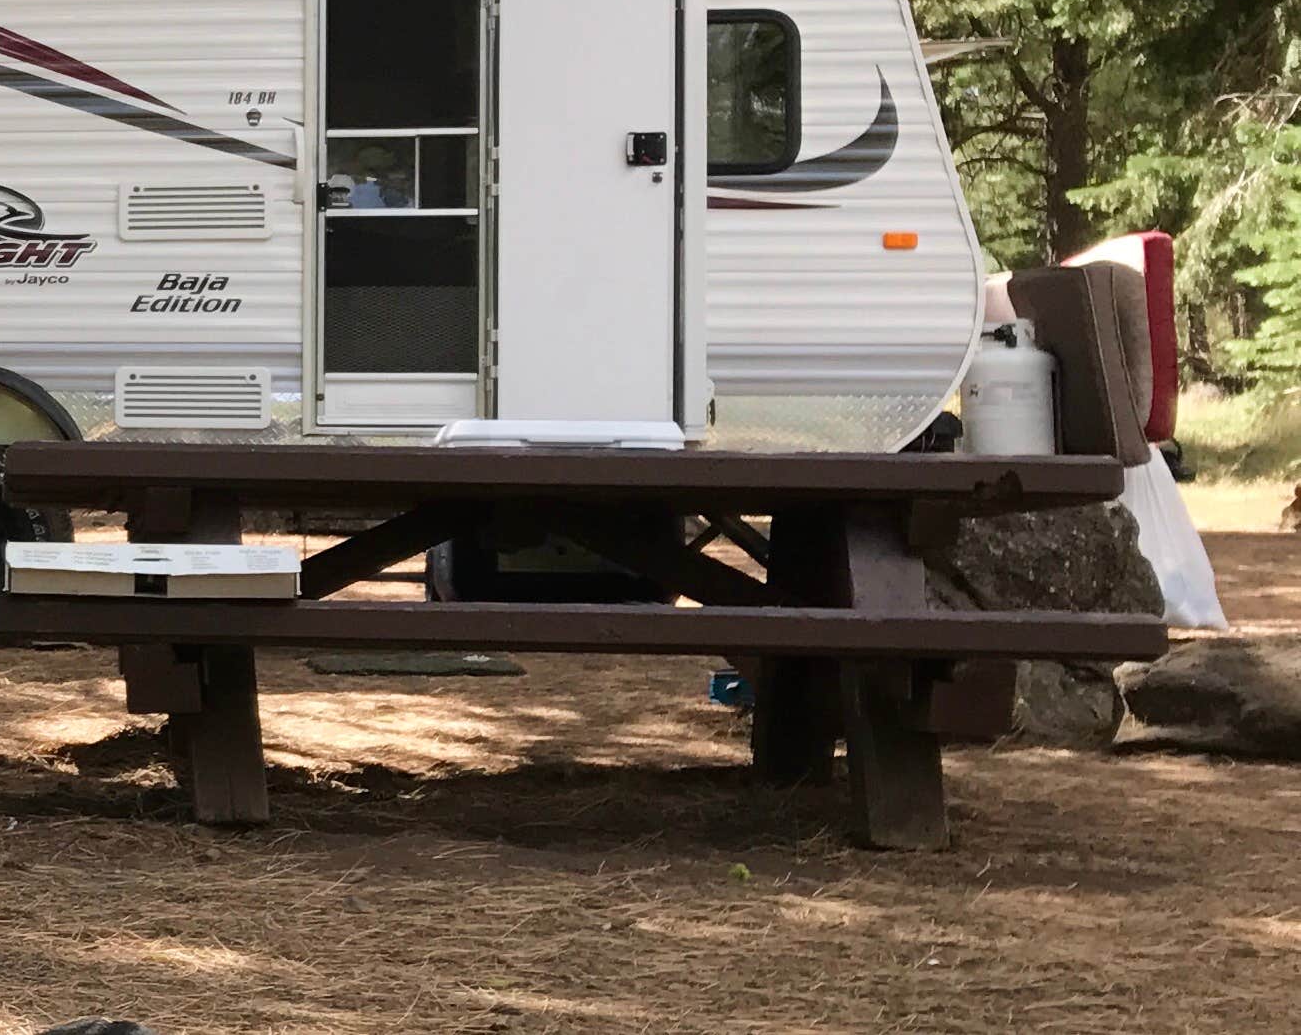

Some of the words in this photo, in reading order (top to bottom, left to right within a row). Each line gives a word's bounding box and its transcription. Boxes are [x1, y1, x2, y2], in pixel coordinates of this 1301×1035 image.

[228, 91, 252, 105] 184
[258, 91, 277, 105] BH
[16, 273, 70, 287] Jayco
[156, 272, 230, 295] Baja
[130, 294, 243, 313] Edition
